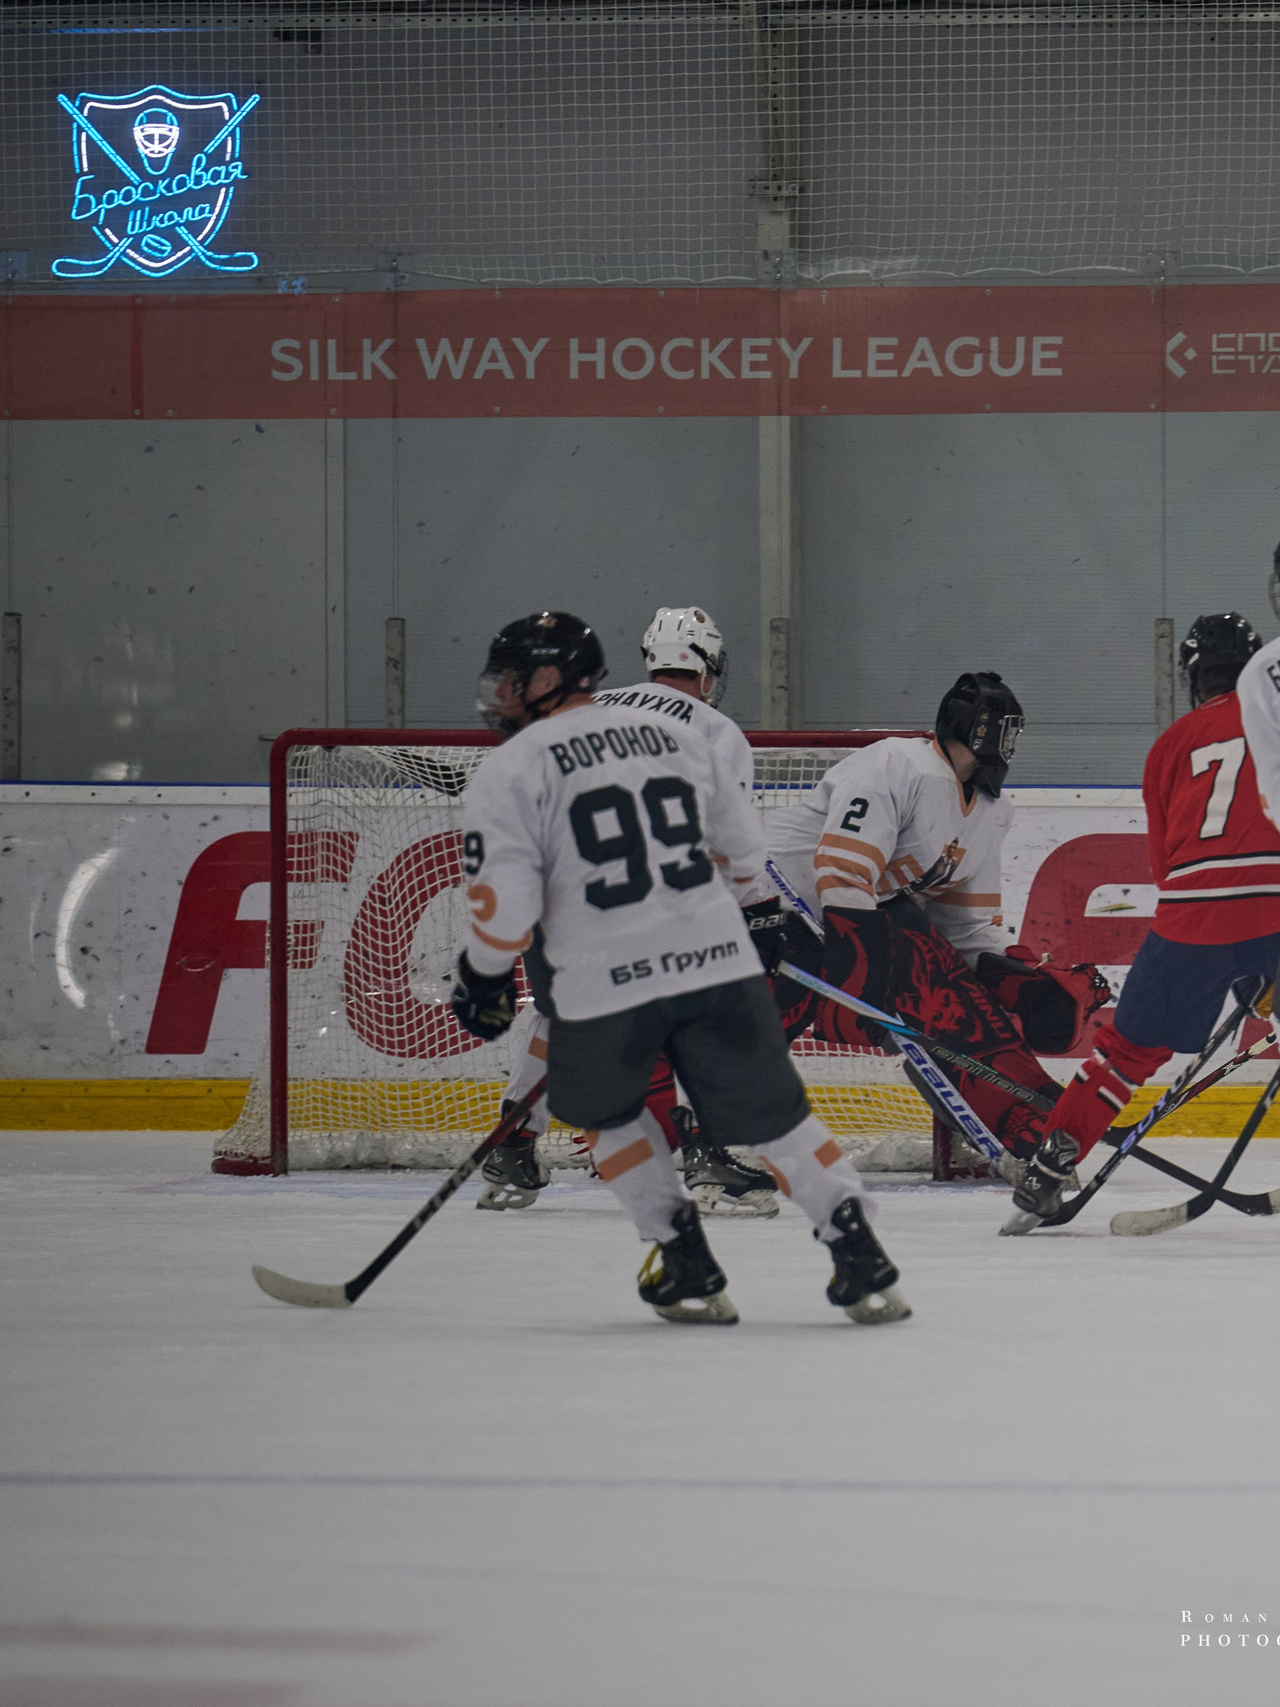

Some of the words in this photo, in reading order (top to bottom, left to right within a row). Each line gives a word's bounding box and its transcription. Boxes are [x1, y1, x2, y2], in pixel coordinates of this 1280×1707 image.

[71, 153, 248, 225] Бросковая
[127, 203, 213, 234] Школа
[271, 338, 398, 381] SILK
[416, 337, 550, 380] WAY
[569, 337, 813, 380] HOCKEY
[832, 336, 1063, 378] LEAGUE
[549, 724, 679, 777] ВОРОНОВ
[1190, 736, 1246, 840] 7
[840, 797, 869, 833] 2
[569, 776, 715, 911] 99
[660, 941, 739, 972] Групп
